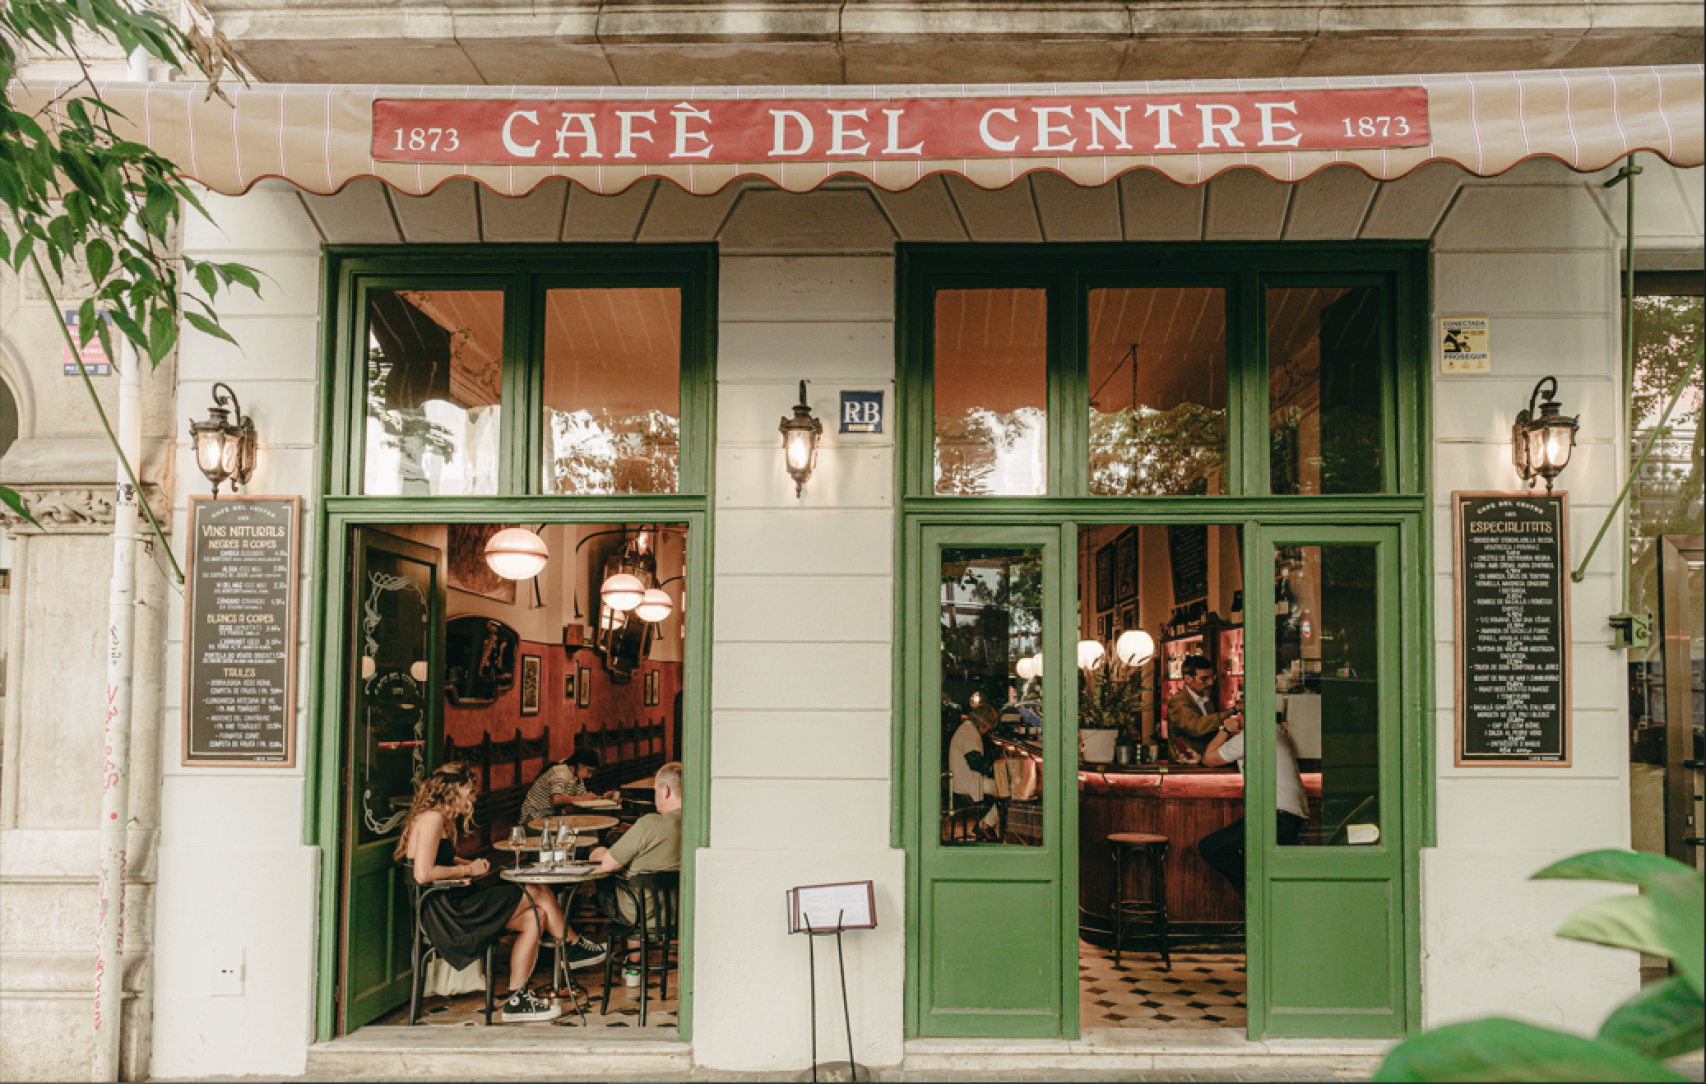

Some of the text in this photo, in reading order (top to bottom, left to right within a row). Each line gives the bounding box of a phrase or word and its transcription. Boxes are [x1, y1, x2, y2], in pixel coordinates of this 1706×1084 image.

[501, 100, 1304, 160] CAFÈ DEL CENTRE
[1341, 116, 1411, 139] 1873
[393, 128, 460, 152] 1873
[843, 401, 881, 424] RB
[202, 525, 285, 537] VINS NATURALS
[1470, 520, 1553, 534] ESPECIALITATS
[246, 613, 275, 624] COPES
